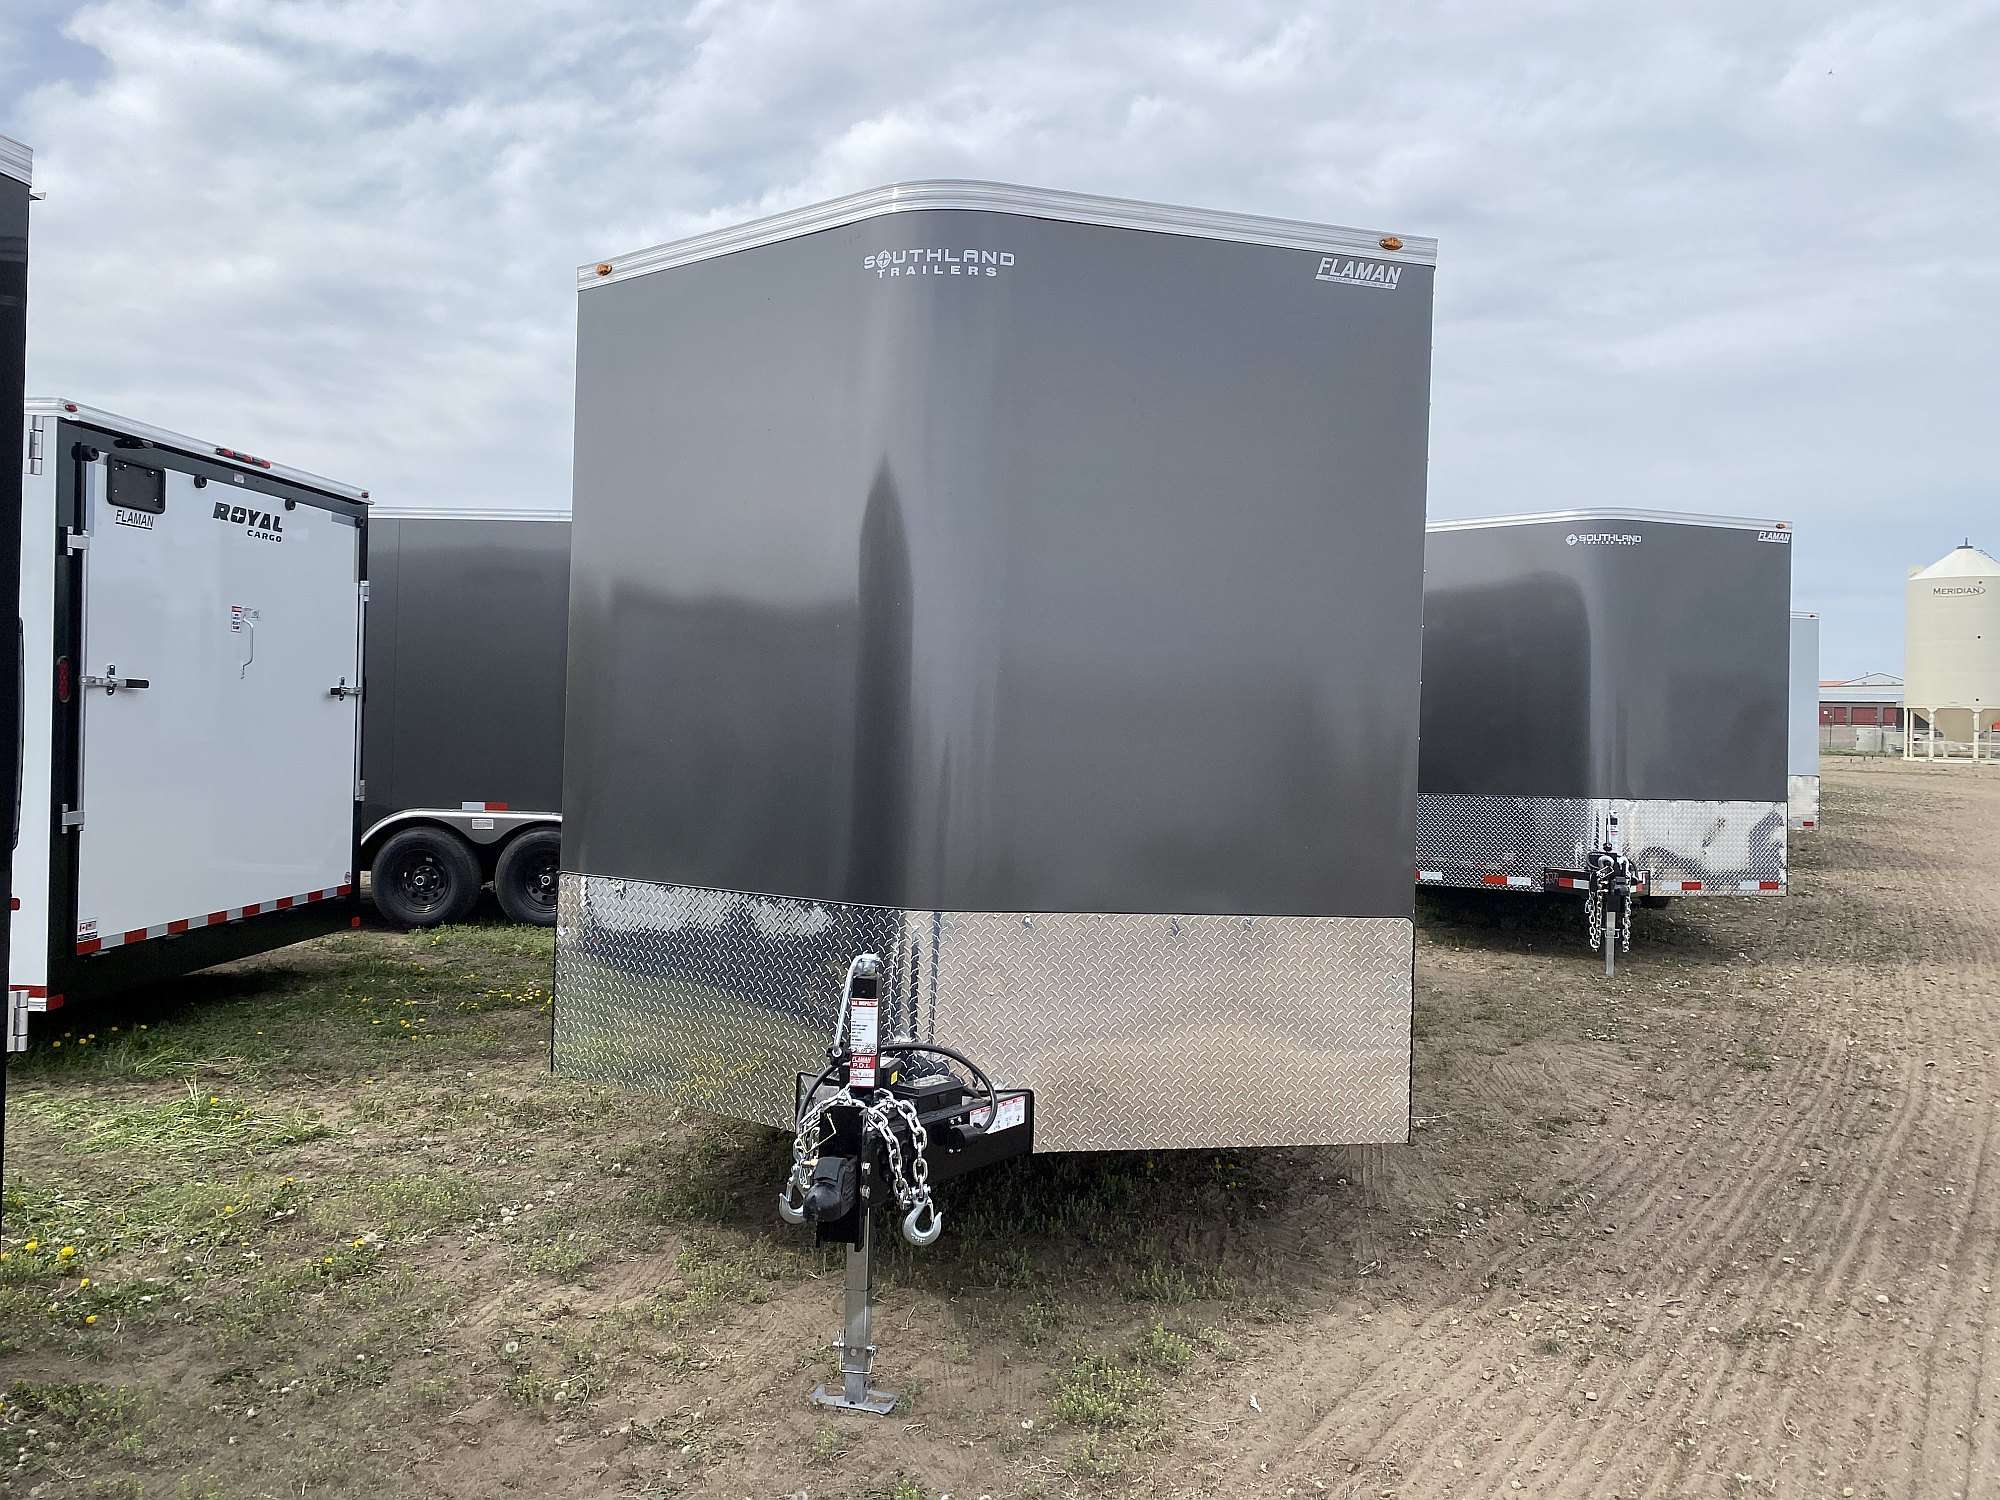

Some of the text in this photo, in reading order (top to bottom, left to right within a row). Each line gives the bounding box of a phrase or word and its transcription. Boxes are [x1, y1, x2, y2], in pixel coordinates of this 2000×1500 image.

[864, 249, 1015, 269] SOUTHLAND
[877, 265, 997, 278] TRAILERS
[1317, 257, 1402, 284] FLAMAN
[115, 509, 154, 527] FLAMAN
[212, 502, 283, 533] ROYAL
[247, 529, 282, 543] CARGO
[1578, 533, 1642, 543] SOUTHLAND
[1759, 531, 1791, 542] FLAMAN
[1933, 587, 1980, 595] MERIDIAN
